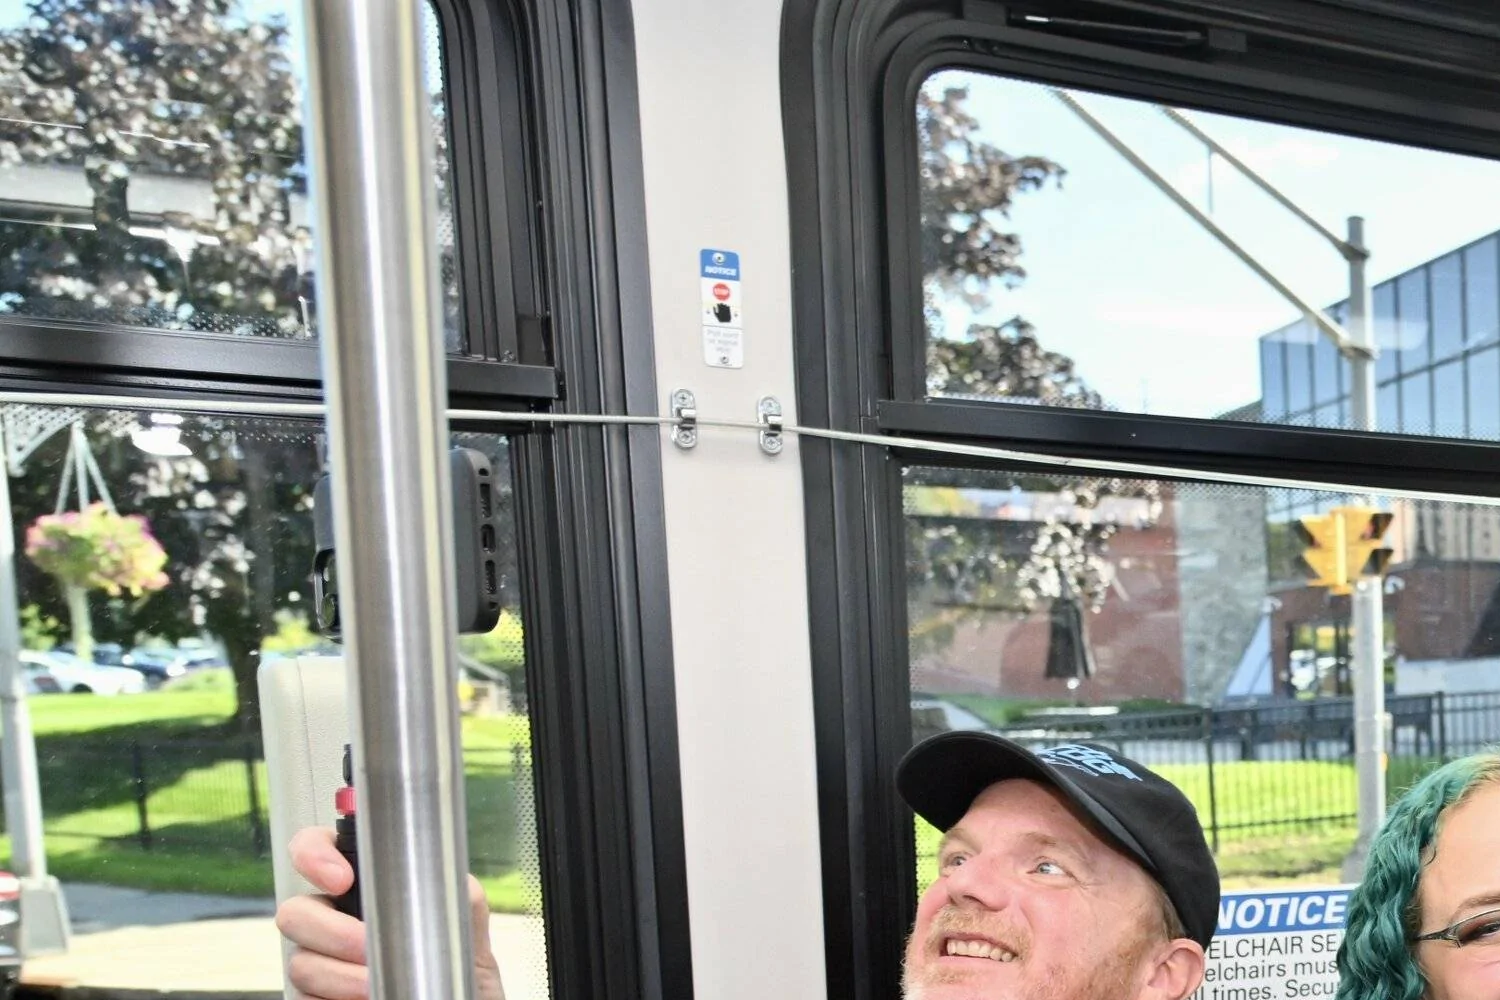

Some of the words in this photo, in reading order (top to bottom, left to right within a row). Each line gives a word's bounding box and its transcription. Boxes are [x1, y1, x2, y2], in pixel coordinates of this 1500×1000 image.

[704, 265, 737, 276] NOTICE
[1217, 894, 1349, 930] NOTICE
[1294, 960, 1338, 976] mus
